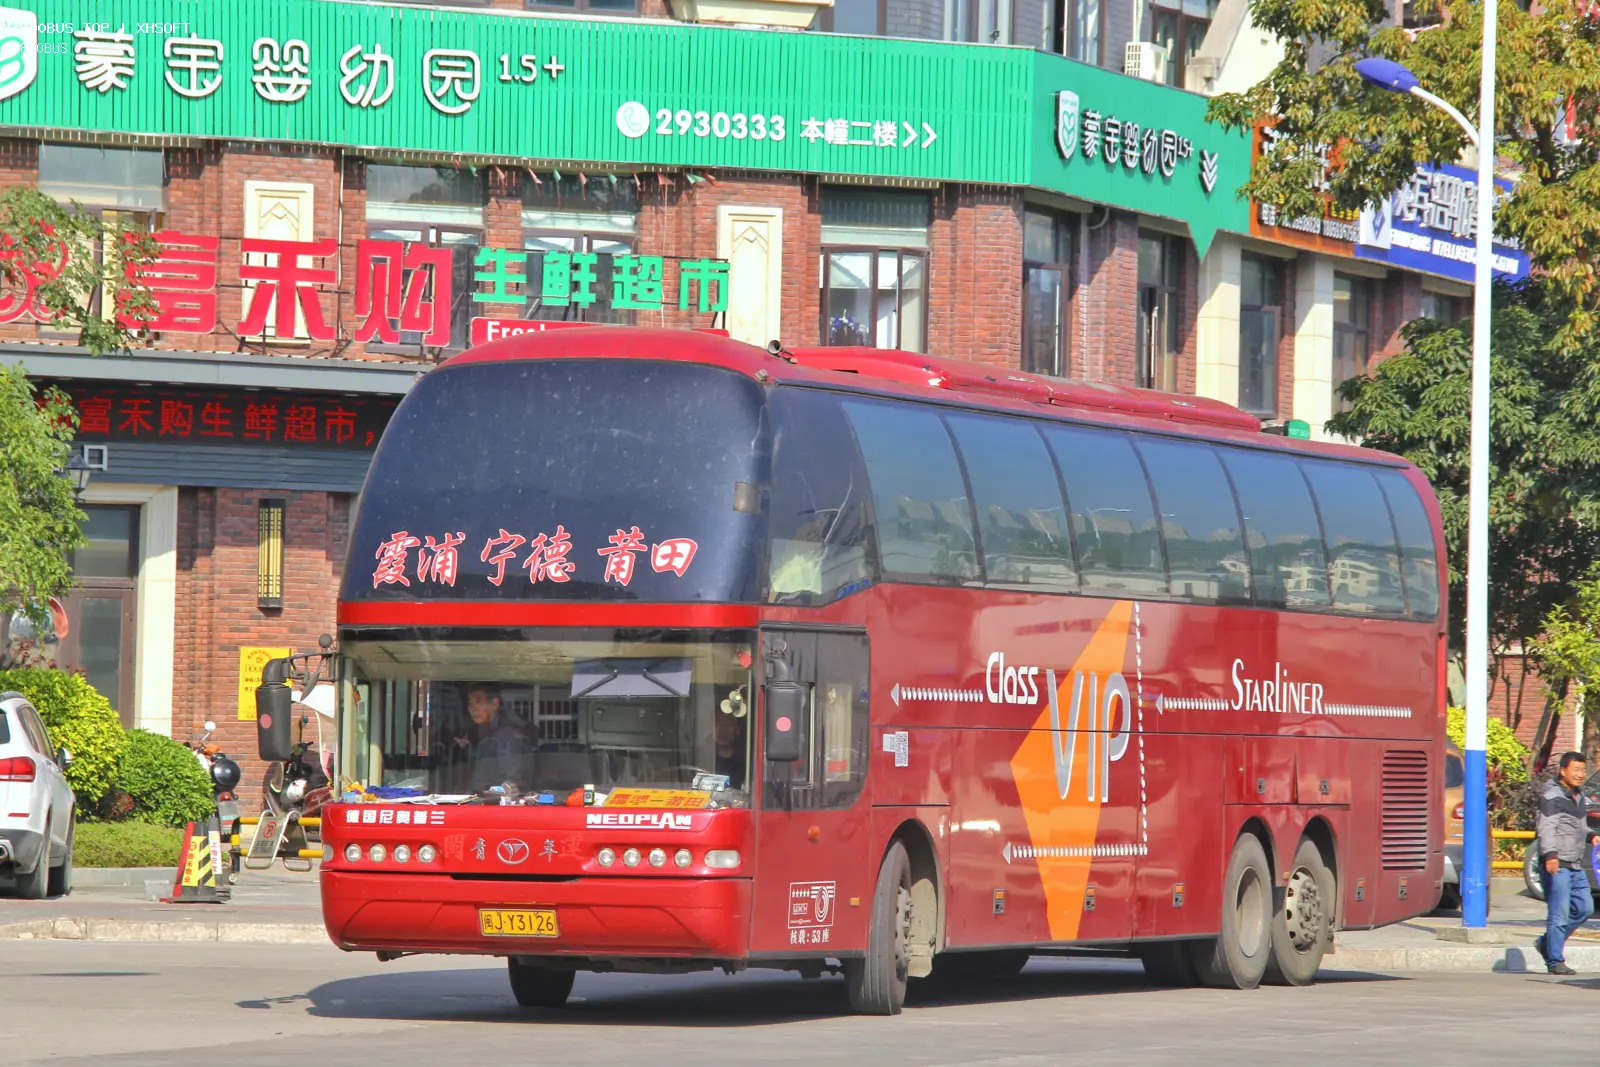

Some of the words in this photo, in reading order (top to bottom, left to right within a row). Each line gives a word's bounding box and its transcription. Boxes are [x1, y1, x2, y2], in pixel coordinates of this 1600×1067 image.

[74, 29, 481, 114] 蒙宝婴幼园
[656, 108, 786, 141] 2930333
[473, 247, 730, 312] 生鲜超市
[373, 530, 466, 588] 霞浦
[480, 525, 576, 587] 宁德
[597, 526, 698, 587] 莆田
[986, 652, 1038, 704] Class
[1046, 669, 1131, 803] VIP
[346, 809, 445, 825] 德国尼奥普兰
[586, 812, 692, 829] NEOPLAN
